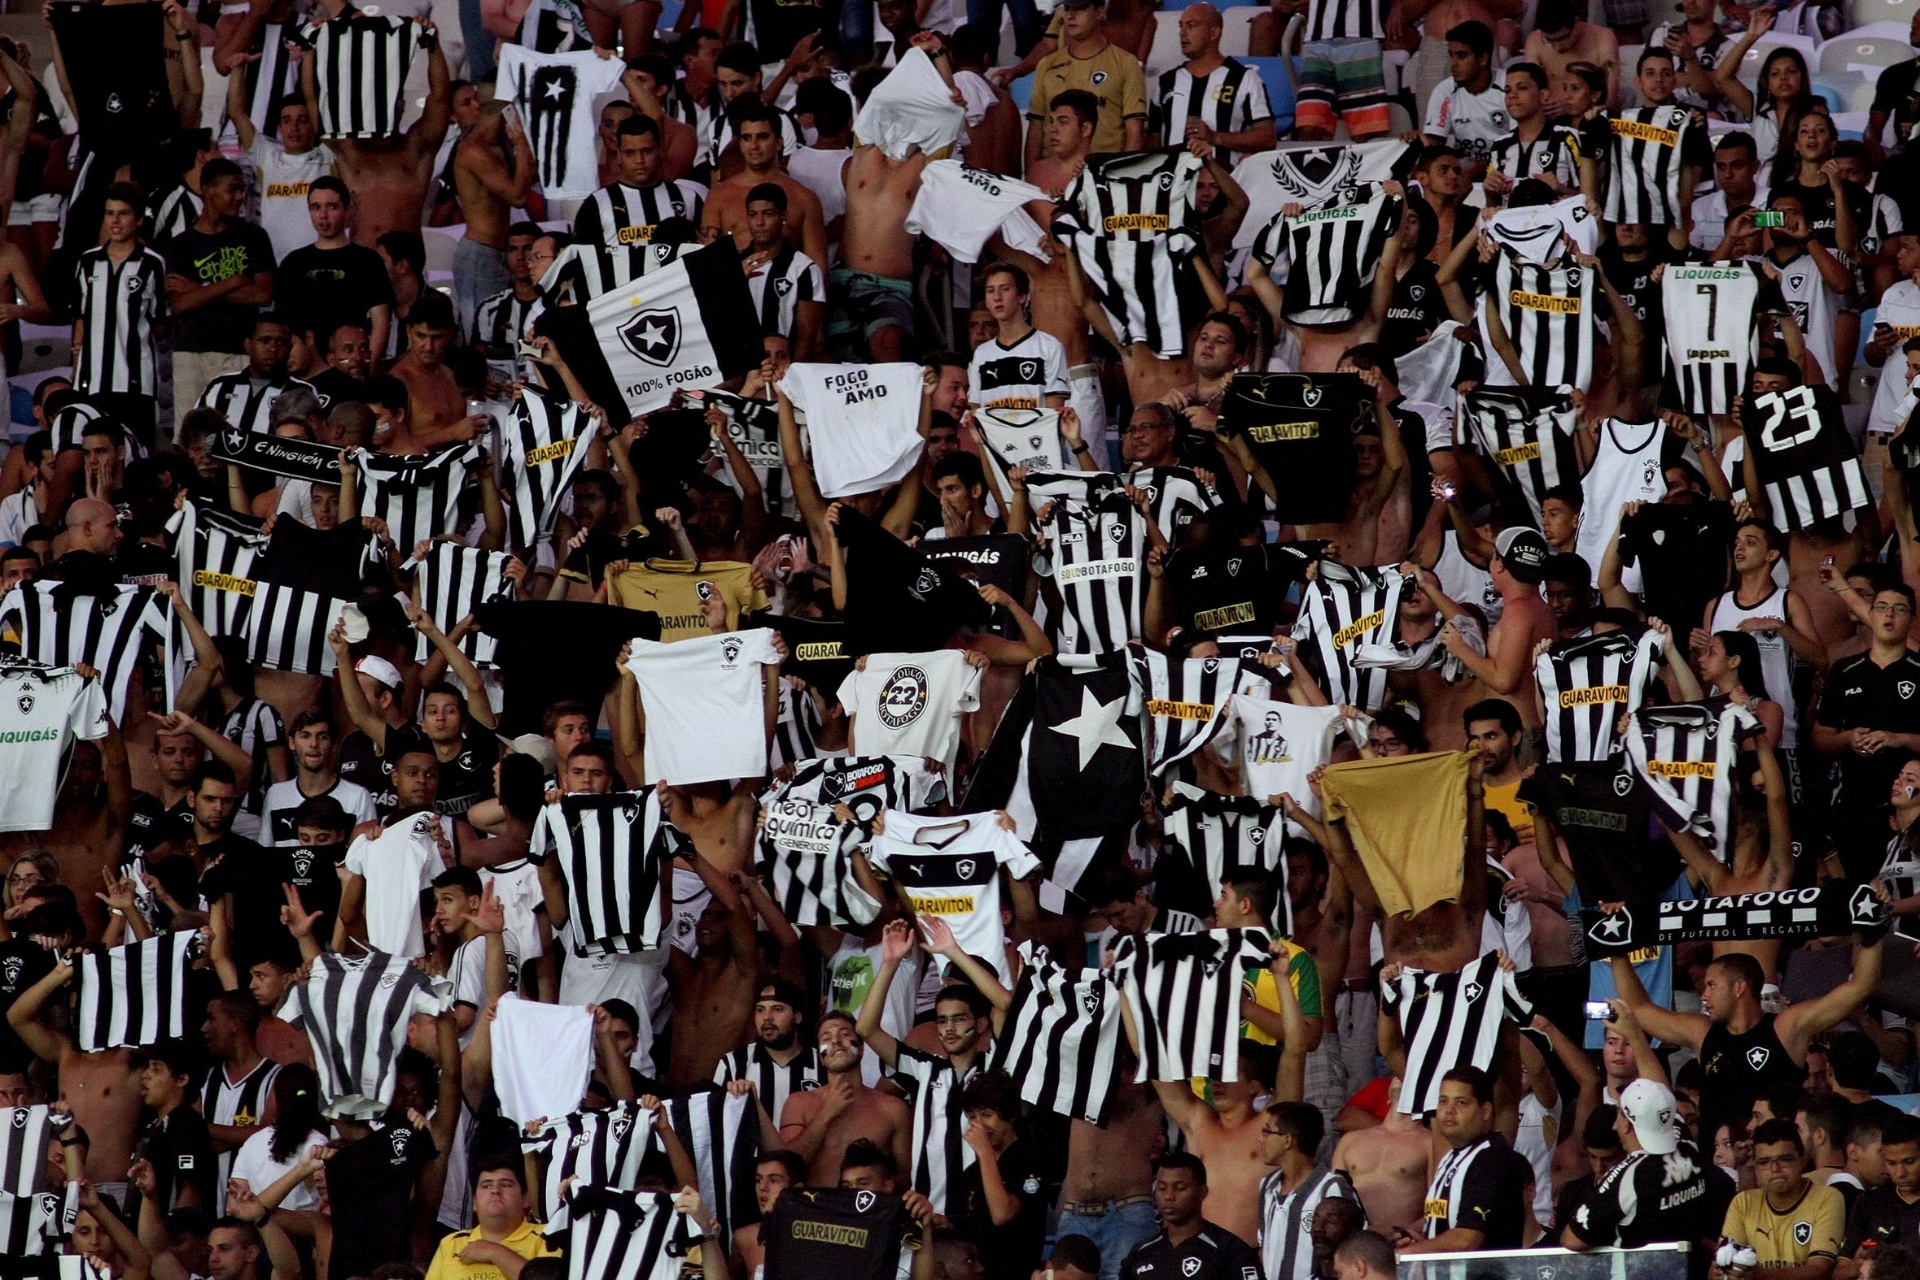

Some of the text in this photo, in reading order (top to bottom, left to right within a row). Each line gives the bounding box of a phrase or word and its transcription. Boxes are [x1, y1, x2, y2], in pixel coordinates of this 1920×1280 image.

[1105, 215, 1168, 232] GUARAVITON
[1297, 206, 1357, 225] LIQUIGÁS
[620, 228, 657, 243] GUARA
[1675, 270, 1741, 280] LIQUIGÁS
[1512, 292, 1580, 313] GUARAVITON
[1386, 306, 1425, 321] UIGÁS
[1697, 284, 1717, 341] 7
[627, 365, 713, 399] 100% FOGÃO
[825, 370, 868, 390] FOGO
[845, 384, 888, 405] AMO
[1754, 384, 1822, 452] 23
[1061, 533, 1082, 543] FILA
[1080, 562, 1135, 577] BOTAFOGO
[659, 614, 704, 629] ARAVITO
[721, 637, 744, 646] LOUCOS
[798, 642, 843, 658] GUARAV
[891, 667, 925, 685] LOUCOS
[888, 686, 916, 705] 22
[1562, 687, 1627, 708] GUARAVITON
[879, 701, 923, 727] BOTAFOGO
[1150, 701, 1213, 720] UARAVITON
[0, 728, 59, 744] IQUIGÁS
[847, 763, 884, 780] BOTAFOGO
[1649, 763, 1714, 779] UARAVITON
[292, 850, 315, 861] LOUCOS
[911, 898, 974, 913] UARAVITON
[1660, 887, 1821, 913] BOTAFOGO
[1659, 924, 1818, 942] DE FUTEBOL E REGATAS
[390, 1128, 412, 1139] LOUCOS
[793, 1223, 867, 1246] GUARAVITON
